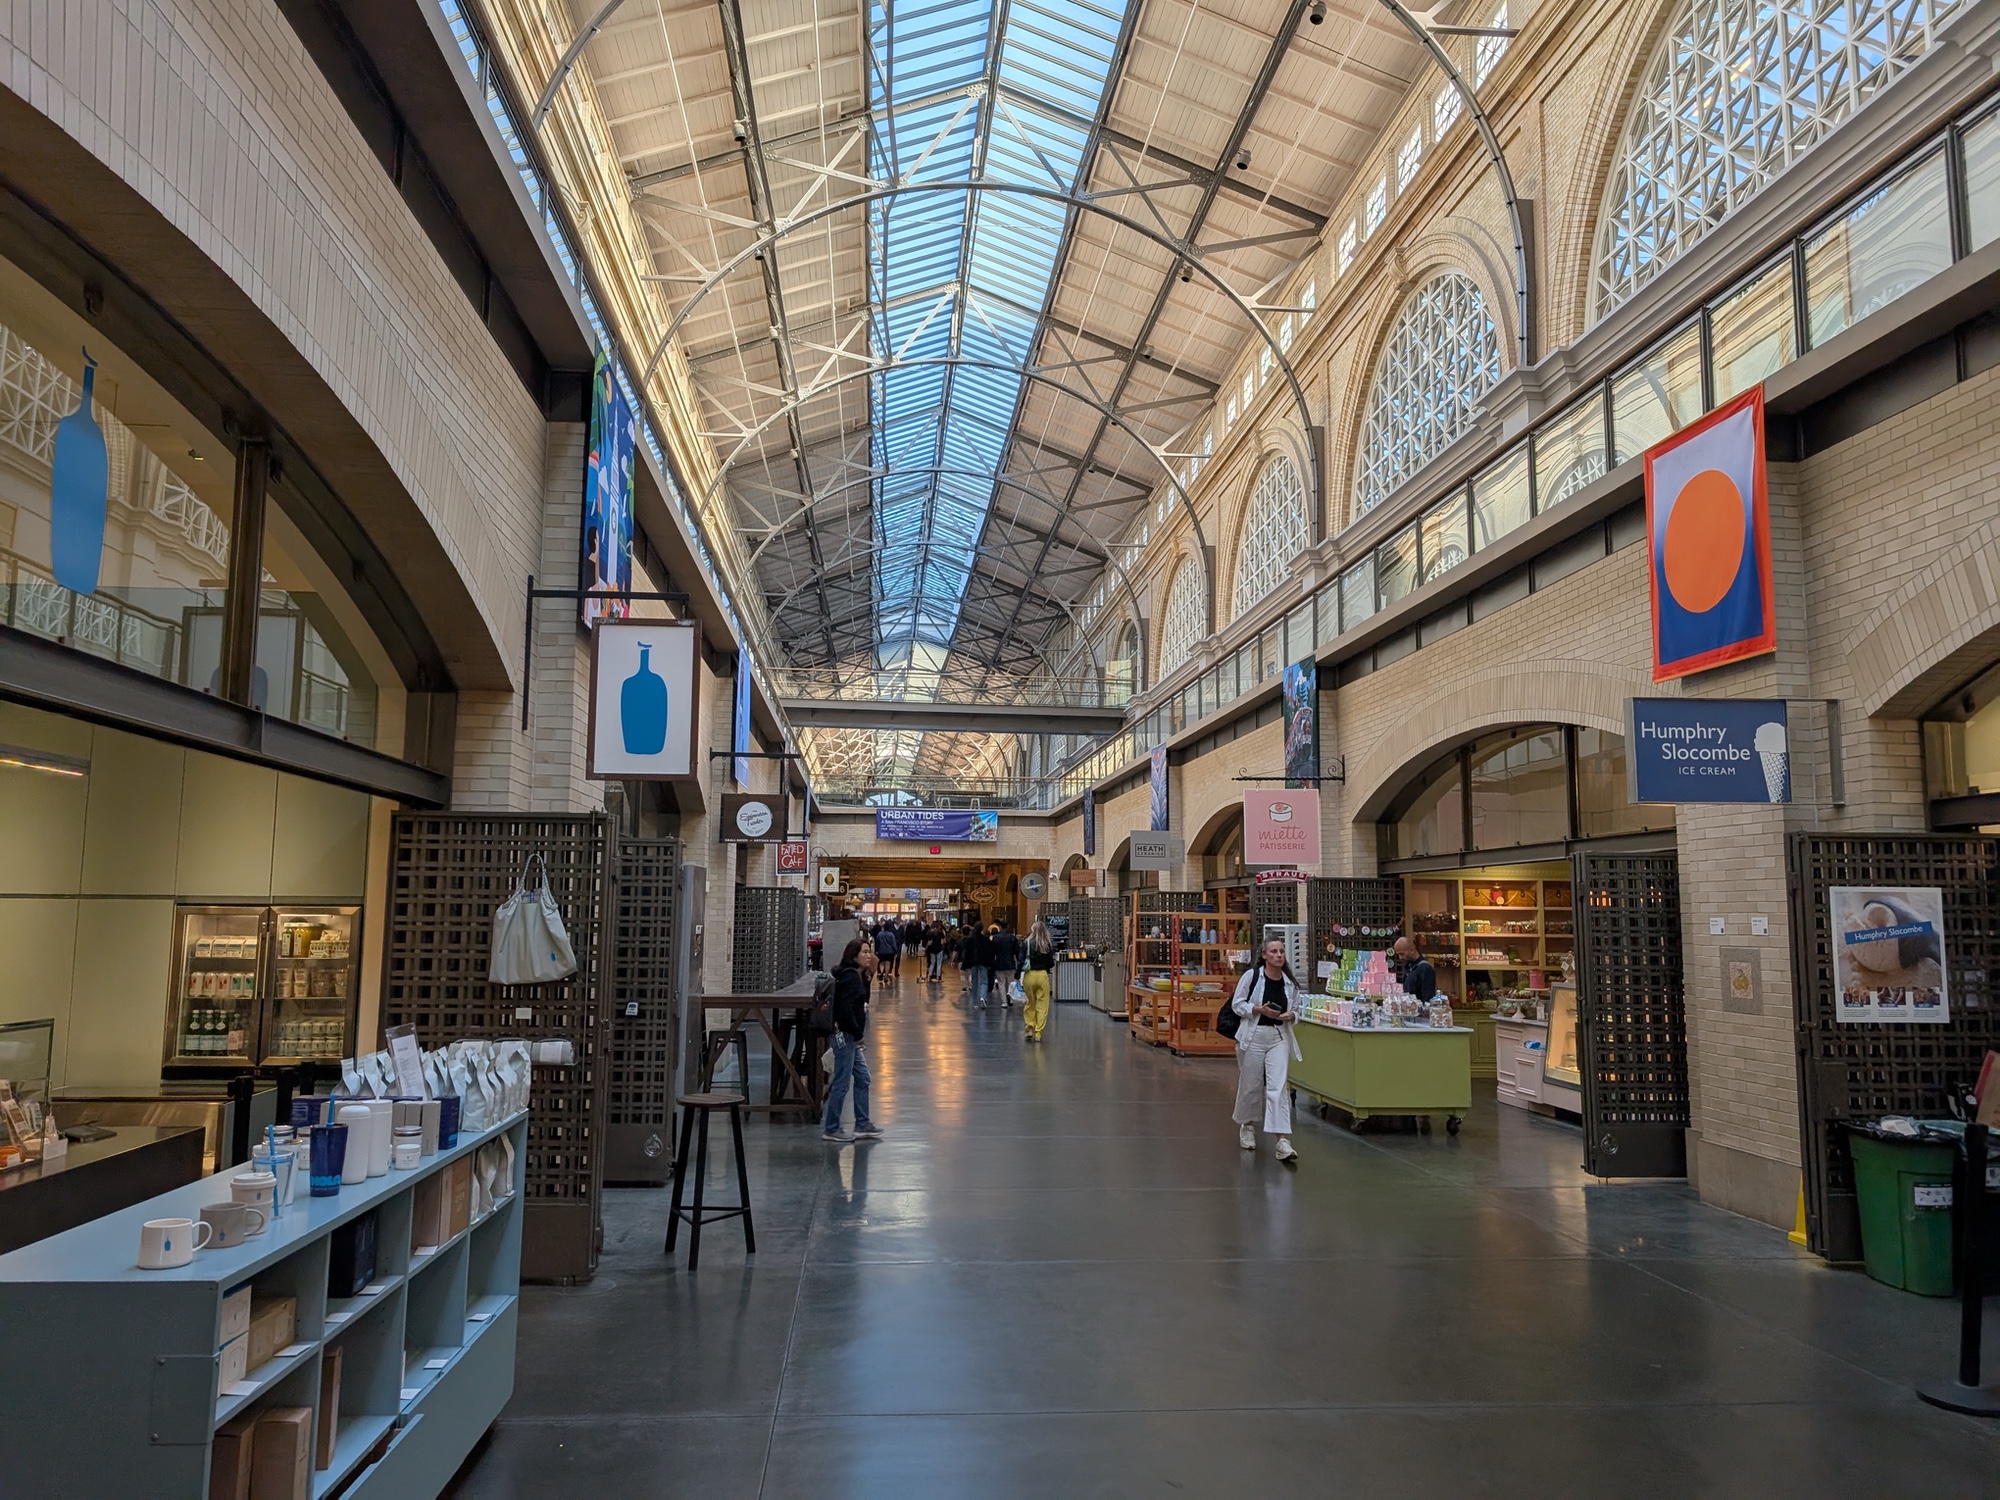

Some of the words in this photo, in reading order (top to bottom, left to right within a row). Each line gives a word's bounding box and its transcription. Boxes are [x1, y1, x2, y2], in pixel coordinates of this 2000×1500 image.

[1641, 721, 1727, 744] Humphry
[1662, 743, 1750, 760] Slocombe
[1678, 766, 1695, 775] ICE
[1699, 767, 1736, 775] CREAM
[880, 811, 915, 819] URBAN
[918, 811, 944, 820] TIDES
[1259, 825, 1307, 840] miette
[781, 844, 805, 855] FATTED
[781, 855, 803, 868] CALF
[1262, 871, 1305, 879] STRAUS
[1855, 930, 1887, 940] Humphry
[1888, 925, 1923, 936] Slocombe
